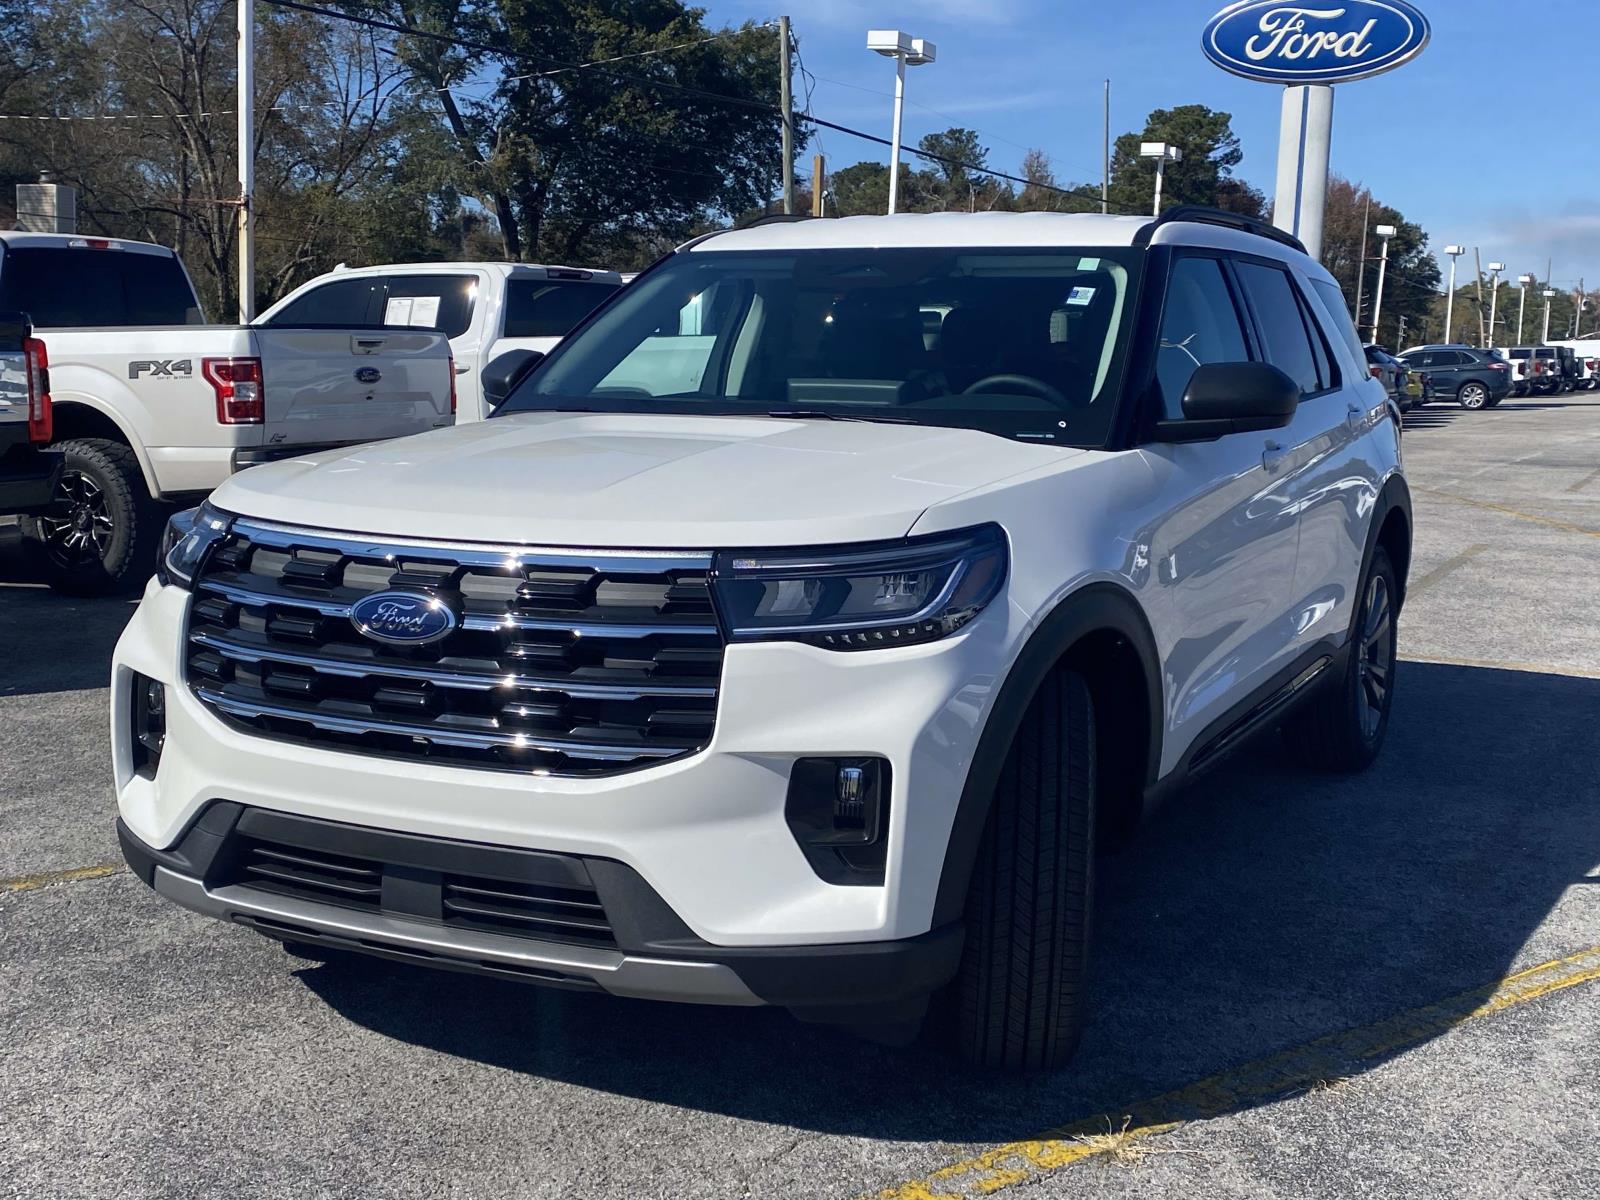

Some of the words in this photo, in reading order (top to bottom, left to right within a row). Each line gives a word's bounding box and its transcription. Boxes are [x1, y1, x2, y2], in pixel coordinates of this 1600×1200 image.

[1245, 8, 1378, 60] Ford
[129, 360, 192, 379] FX4
[371, 601, 429, 632] Ford
